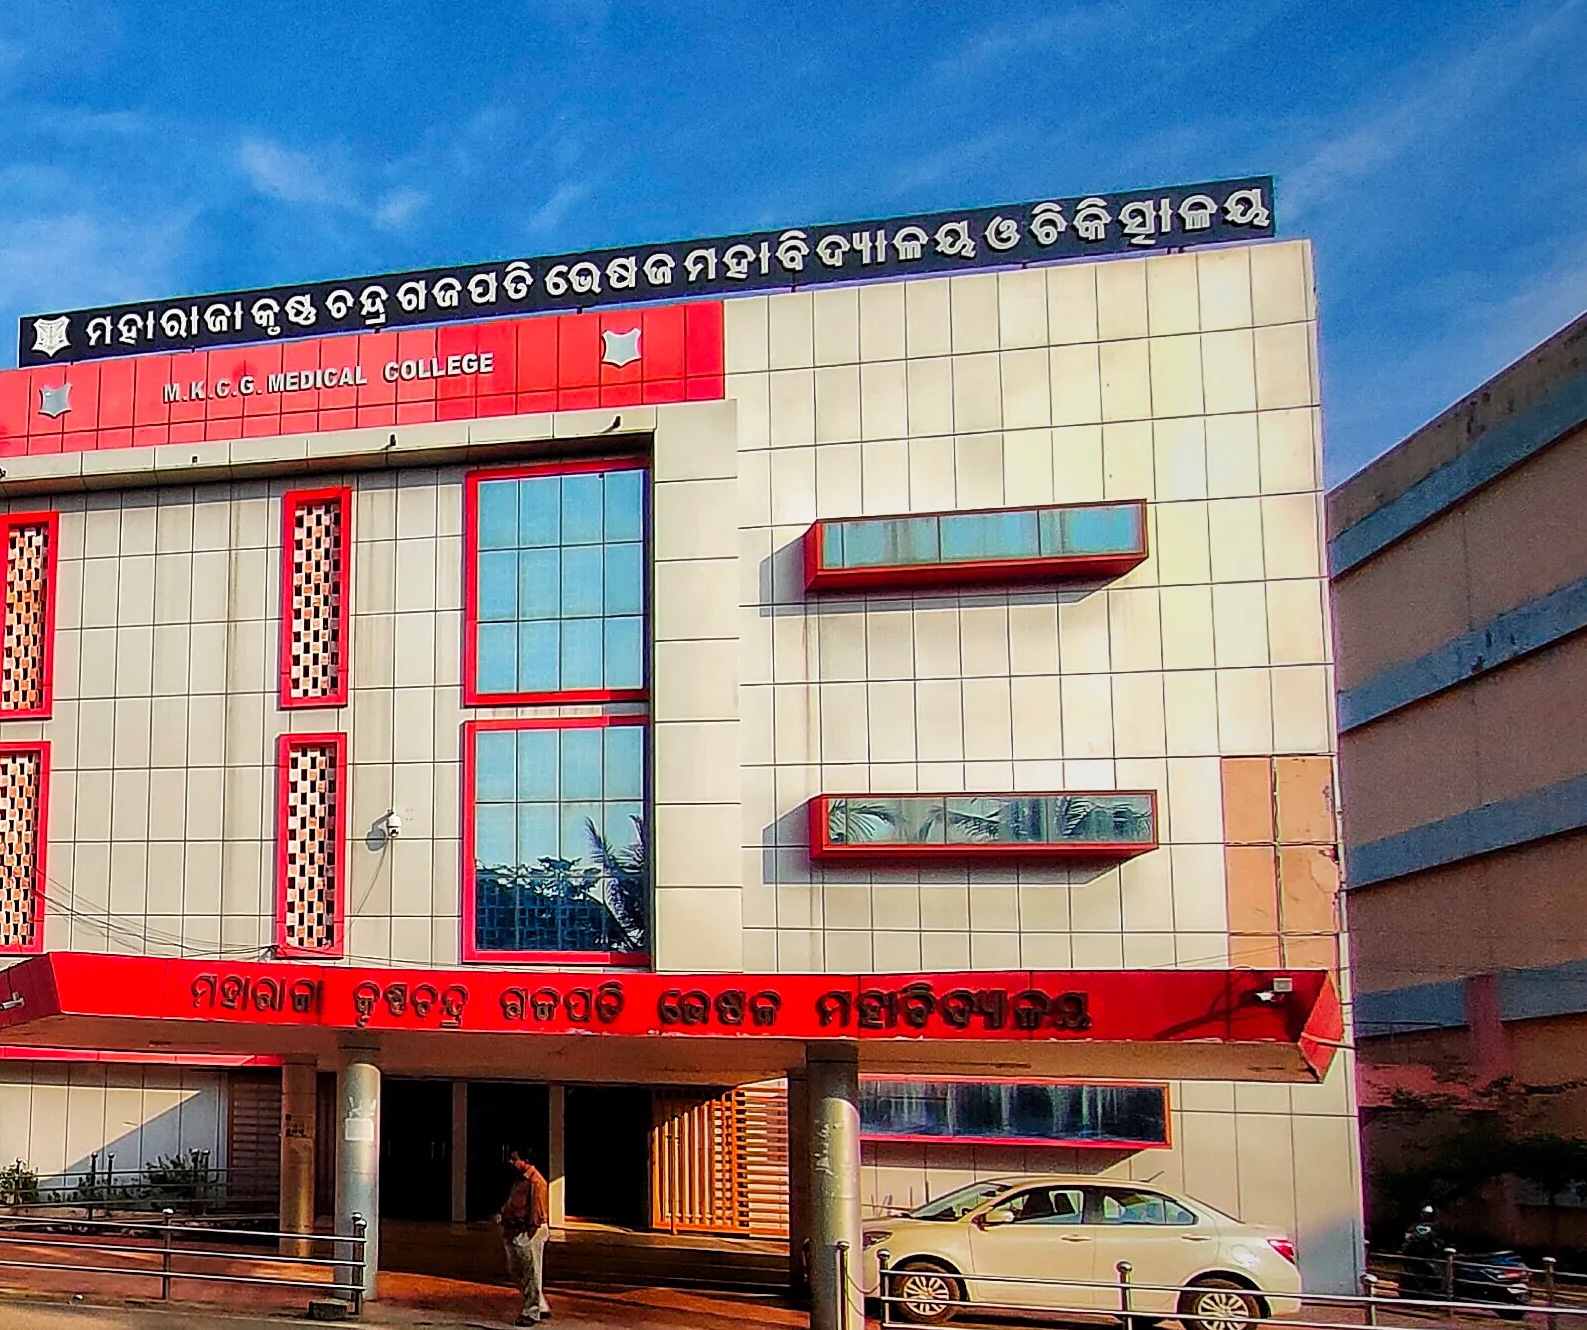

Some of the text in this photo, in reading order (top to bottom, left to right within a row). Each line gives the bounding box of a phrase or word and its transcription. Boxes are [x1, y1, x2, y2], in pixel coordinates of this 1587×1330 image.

[86, 300, 243, 346] ମହାରାଜା
[252, 293, 317, 336] କୃଷ୍ଣ
[396, 261, 533, 312] ଗଜପତି
[544, 253, 675, 295] ଭେଷଜ
[683, 219, 976, 282] ମହାବିଦ୍ୟାଳୟ
[984, 216, 1021, 250] ଓ
[163, 352, 494, 403] M.K.C.G. MEDICAL COLLEGE
[191, 973, 325, 1012] ମହାରାଜା
[499, 980, 625, 1022] ଗଜପତି
[658, 988, 782, 1026] ଭେଷଜ
